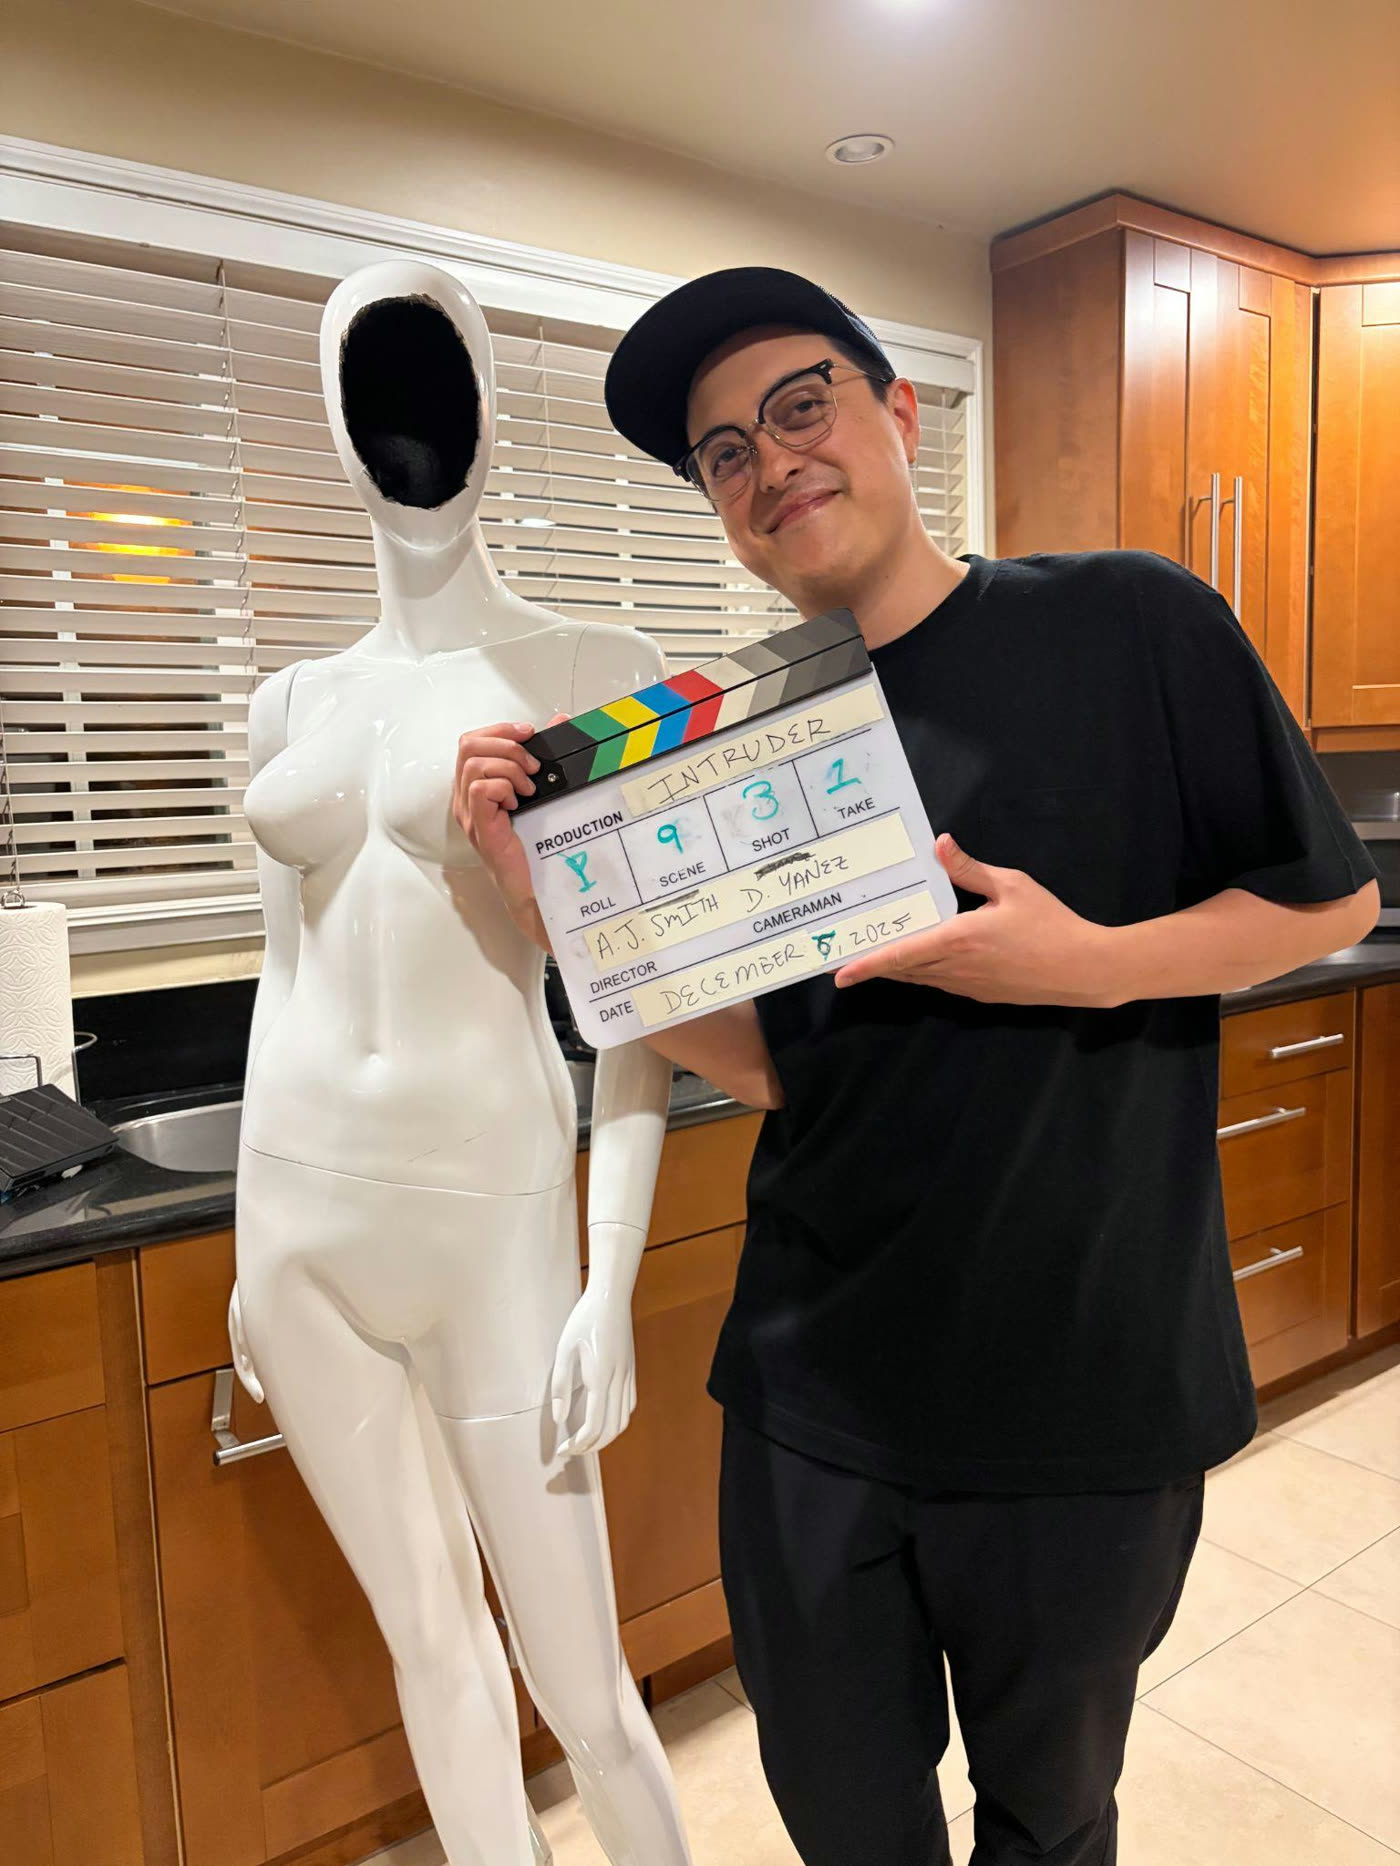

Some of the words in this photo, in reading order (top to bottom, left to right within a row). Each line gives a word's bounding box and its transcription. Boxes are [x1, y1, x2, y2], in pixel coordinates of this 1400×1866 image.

[648, 719, 831, 805] INTRUDER
[827, 758, 862, 795] 1
[742, 780, 779, 821] 3
[837, 797, 876, 820] TAKE
[535, 811, 624, 854] PRODUCTION
[656, 823, 684, 854] 9
[751, 828, 791, 852] SHOT
[659, 861, 707, 887] SCENE
[740, 888, 770, 912] D.
[779, 856, 849, 896] YANEZ
[580, 897, 617, 917] ROLL
[753, 891, 843, 933] CAMERAMAN
[590, 961, 658, 994] DIRECTOR
[659, 943, 805, 1014] DECEMBER
[849, 912, 912, 946] 2025
[600, 1000, 635, 1023] DATE
